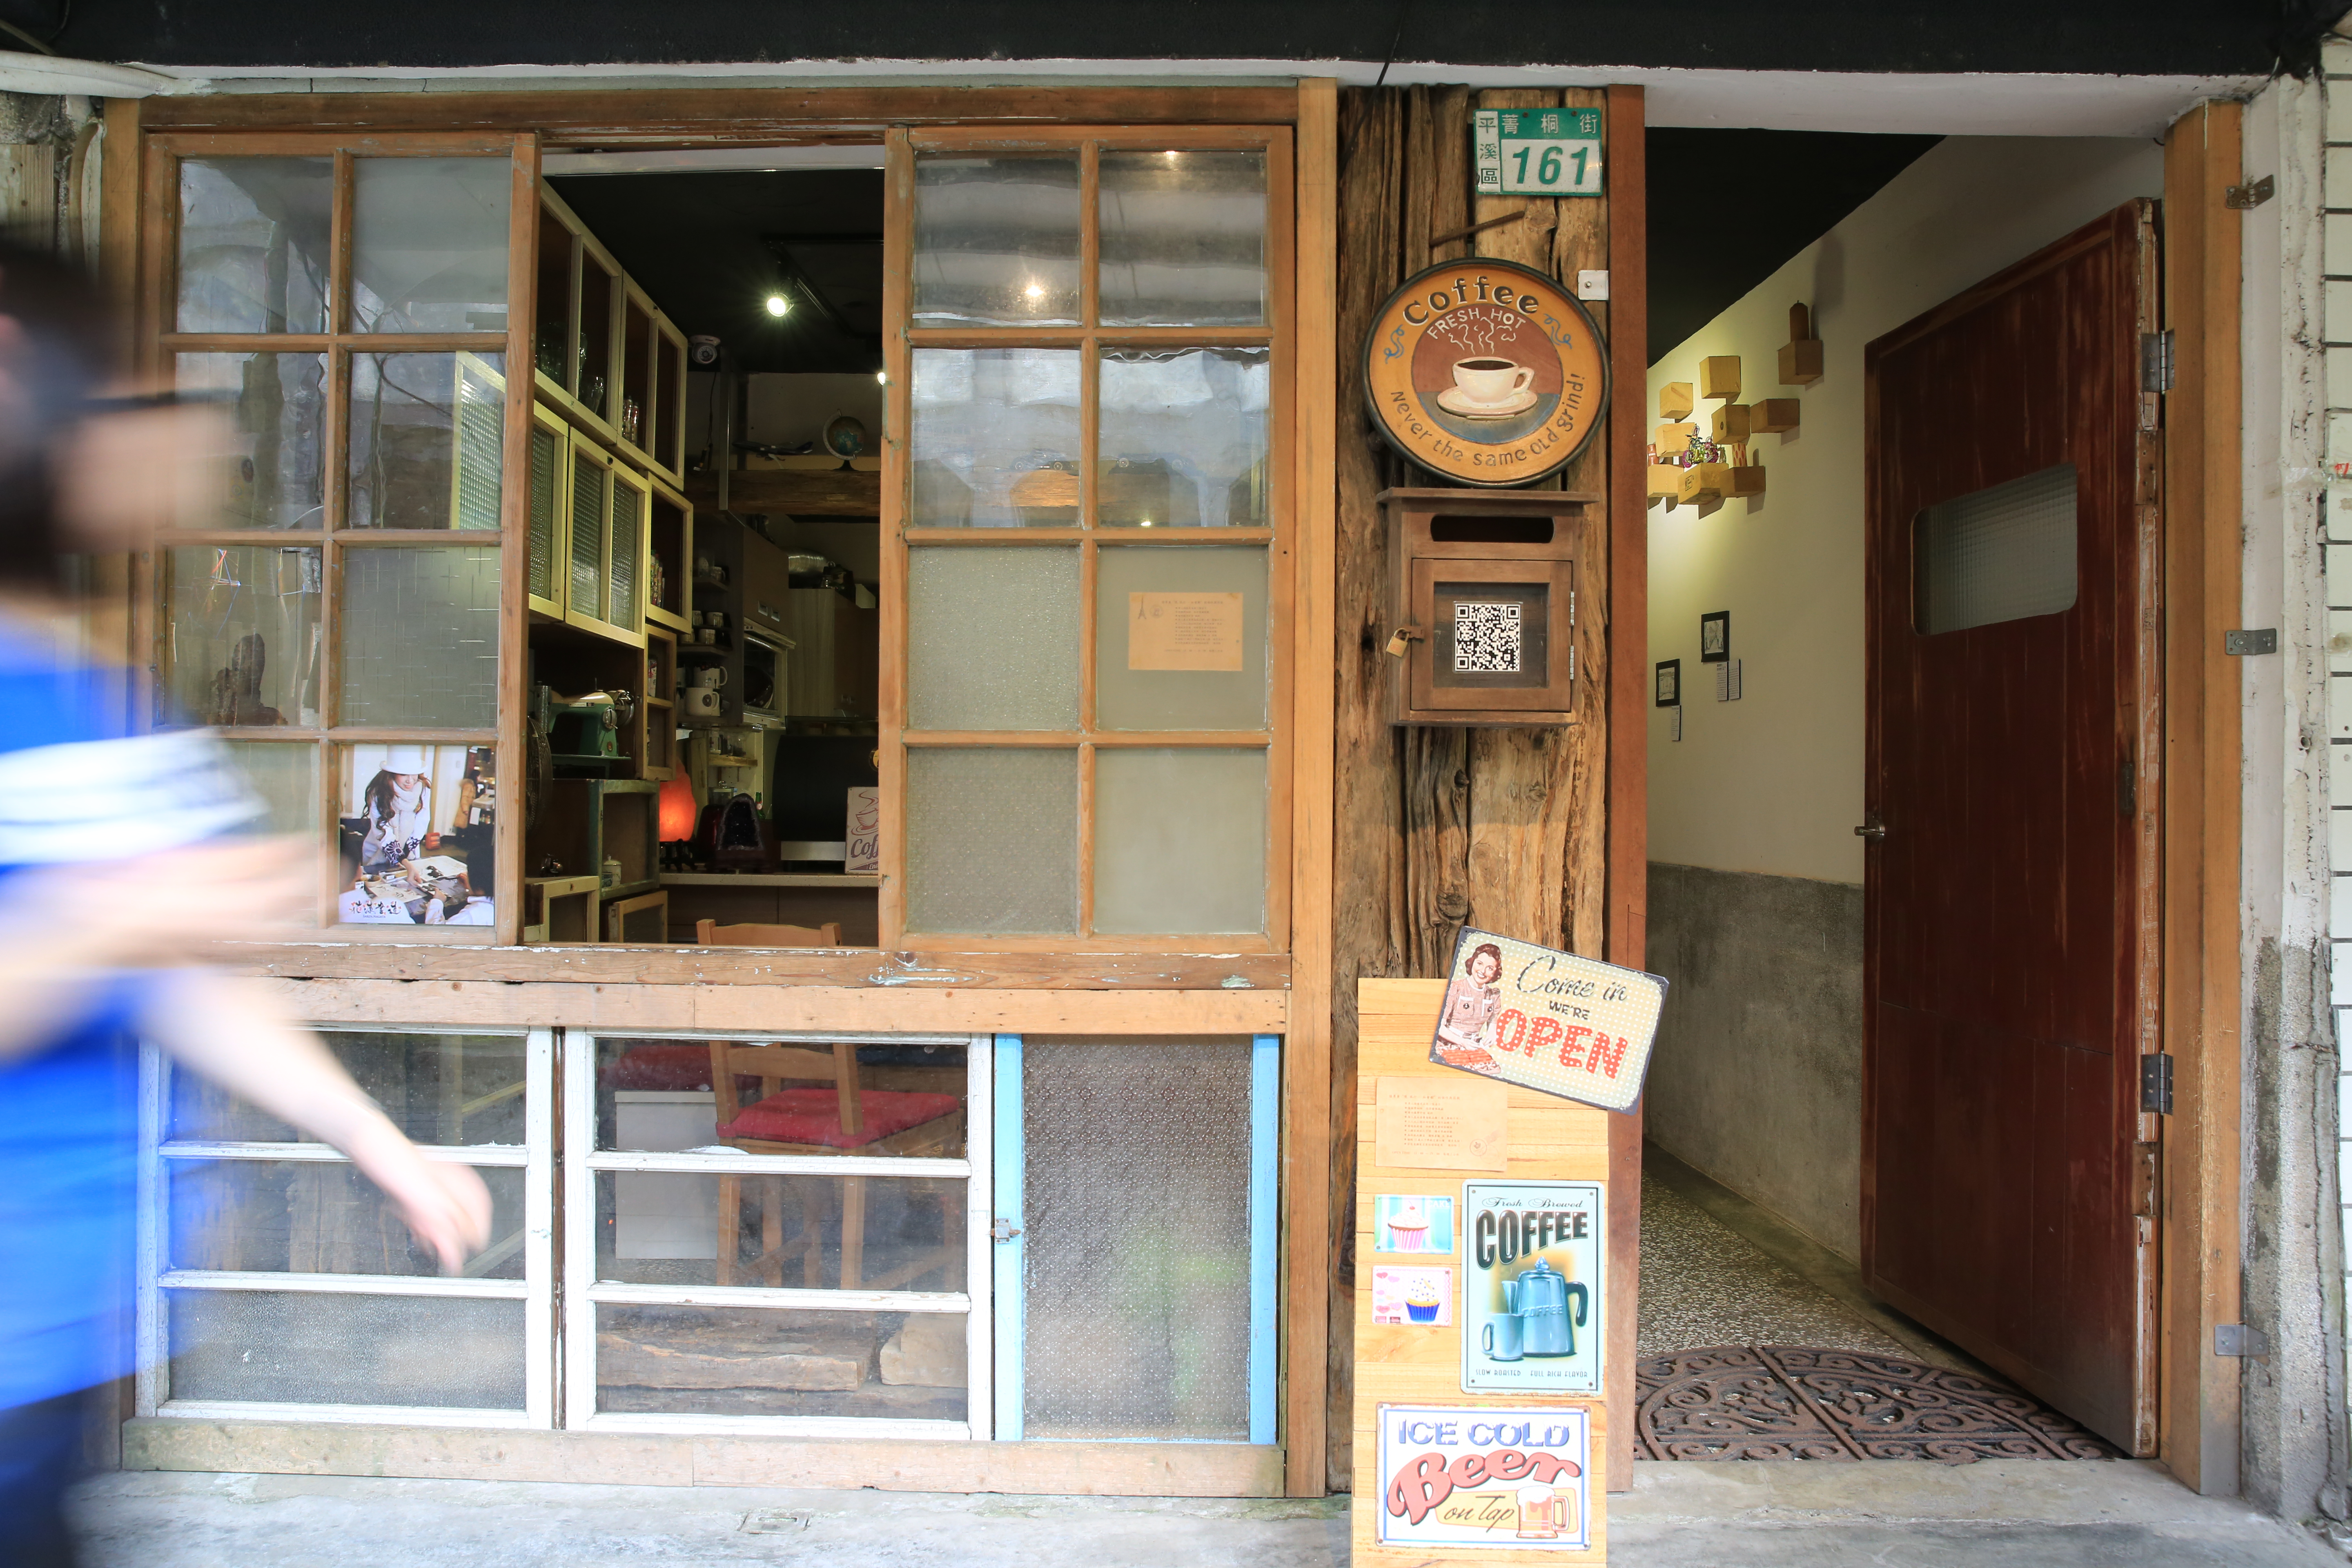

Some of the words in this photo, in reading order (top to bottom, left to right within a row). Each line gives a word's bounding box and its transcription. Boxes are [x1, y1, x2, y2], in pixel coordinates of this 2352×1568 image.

[1501, 114, 1597, 134] 菁桐街
[1478, 117, 1499, 185] 平溪區
[1512, 146, 1588, 185] 161
[1403, 276, 1539, 326] Coffee
[1427, 307, 1480, 340] FRESH
[1490, 308, 1526, 329] HOT
[1391, 391, 1433, 439] Never
[1433, 439, 1463, 462] the
[1472, 448, 1527, 467] same
[1557, 373, 1585, 432] grind!
[1516, 955, 1595, 998] Come
[1603, 981, 1628, 1001] in
[1549, 1000, 1590, 1020] WE'RE
[1496, 1009, 1628, 1079] OPEN
[1482, 1196, 1523, 1207] Fresh
[1528, 1197, 1584, 1208] Brewed
[1475, 1209, 1588, 1270] COFFEE
[1521, 1304, 1563, 1318] COFFEE
[1399, 1419, 1458, 1445] ICE
[1468, 1421, 1570, 1447] COLD
[1387, 1449, 1582, 1526] Beer
[1443, 1505, 1476, 1520] on
[1475, 1495, 1515, 1533] Tap
